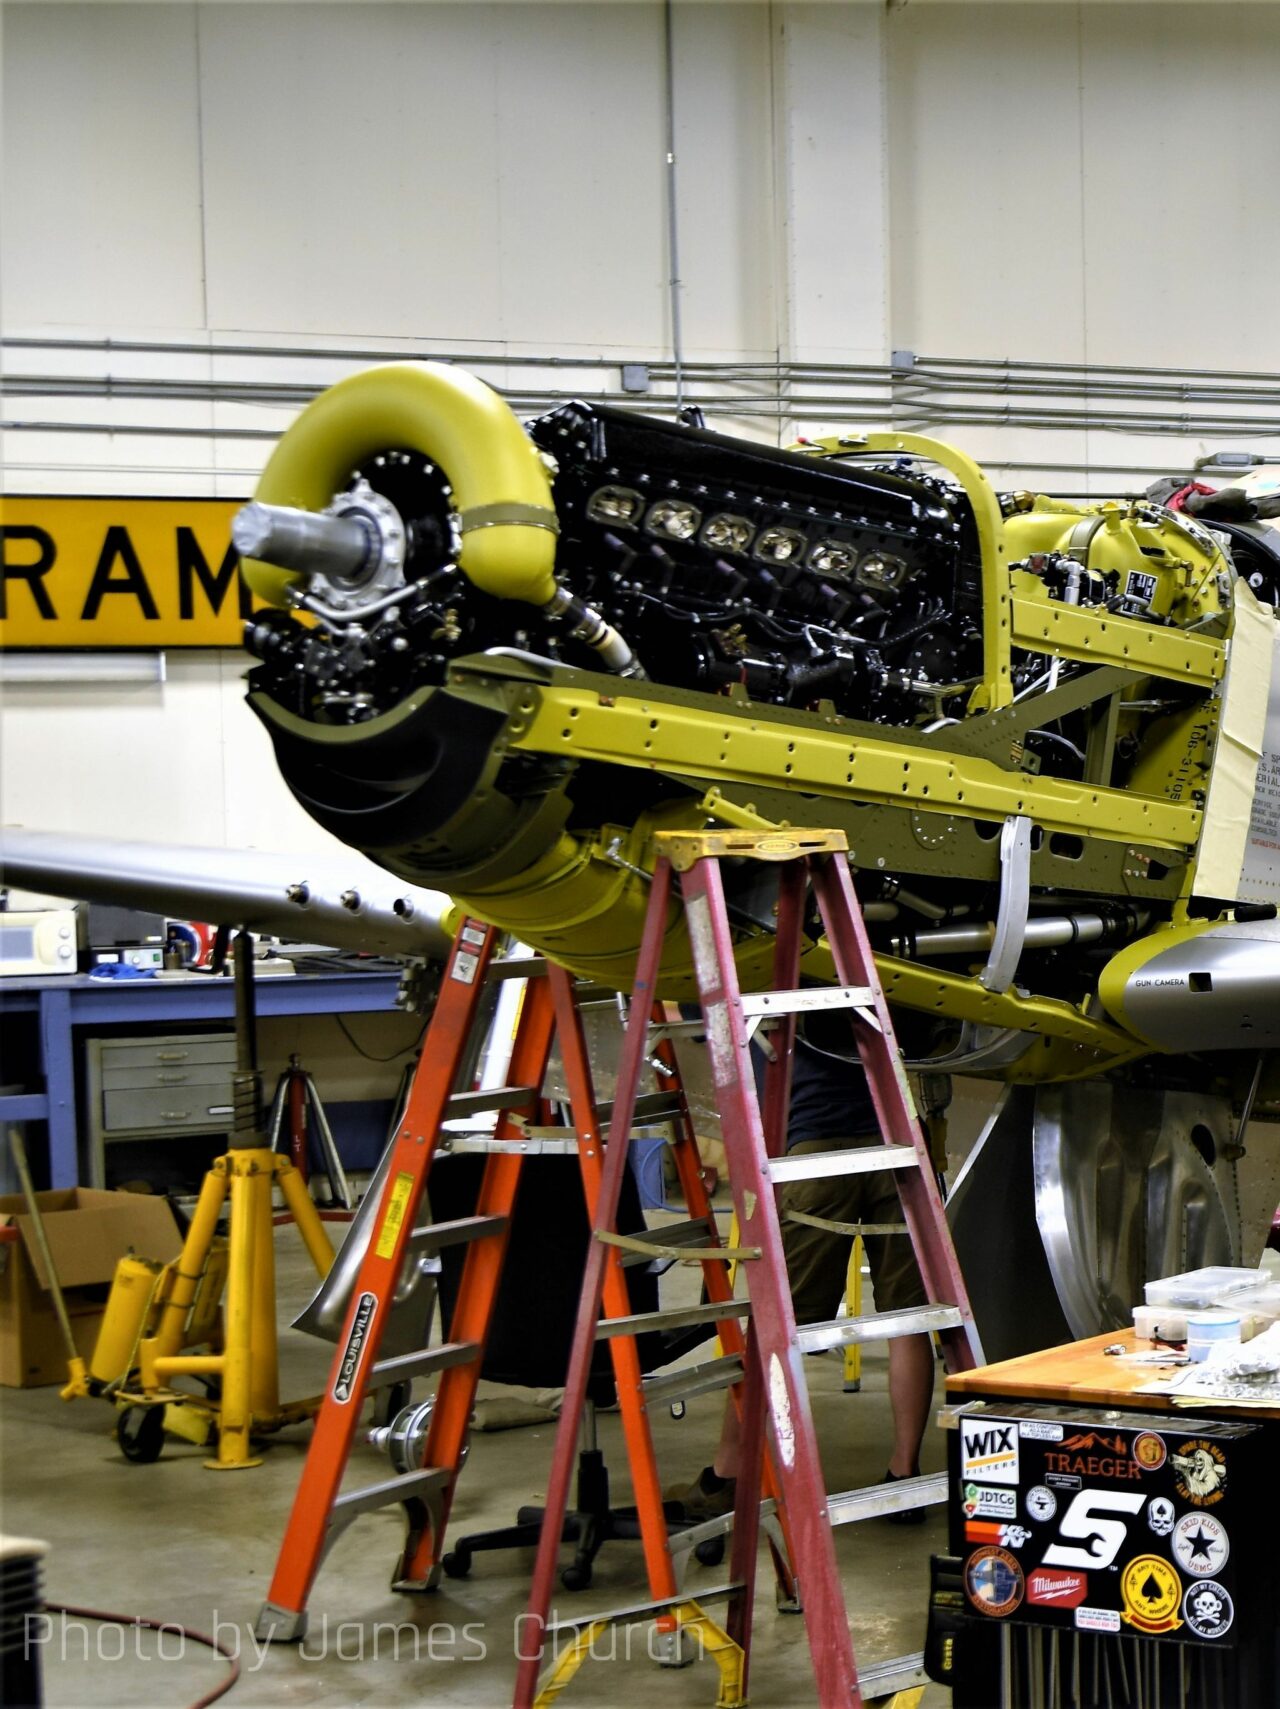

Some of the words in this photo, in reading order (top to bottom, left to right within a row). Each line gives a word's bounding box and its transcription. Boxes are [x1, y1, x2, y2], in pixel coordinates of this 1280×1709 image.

[0, 525, 253, 620] RAM
[1256, 773, 1280, 788] ERIAL
[1135, 979, 1152, 987] GUN
[1154, 978, 1185, 987] CAMERA
[341, 1295, 374, 1385] LOUISVILLE
[964, 1426, 1015, 1458] WIX
[965, 1460, 1017, 1476] FILTERS
[1043, 1452, 1143, 1480] TRAEGER
[979, 1491, 1015, 1505] JDTCo
[1180, 1517, 1200, 1534] SKID
[1201, 1518, 1220, 1536] KIDS
[1136, 1564, 1150, 1573] ANY
[1188, 1559, 1214, 1573] USMC
[1032, 1576, 1081, 1594] Milwaukee
